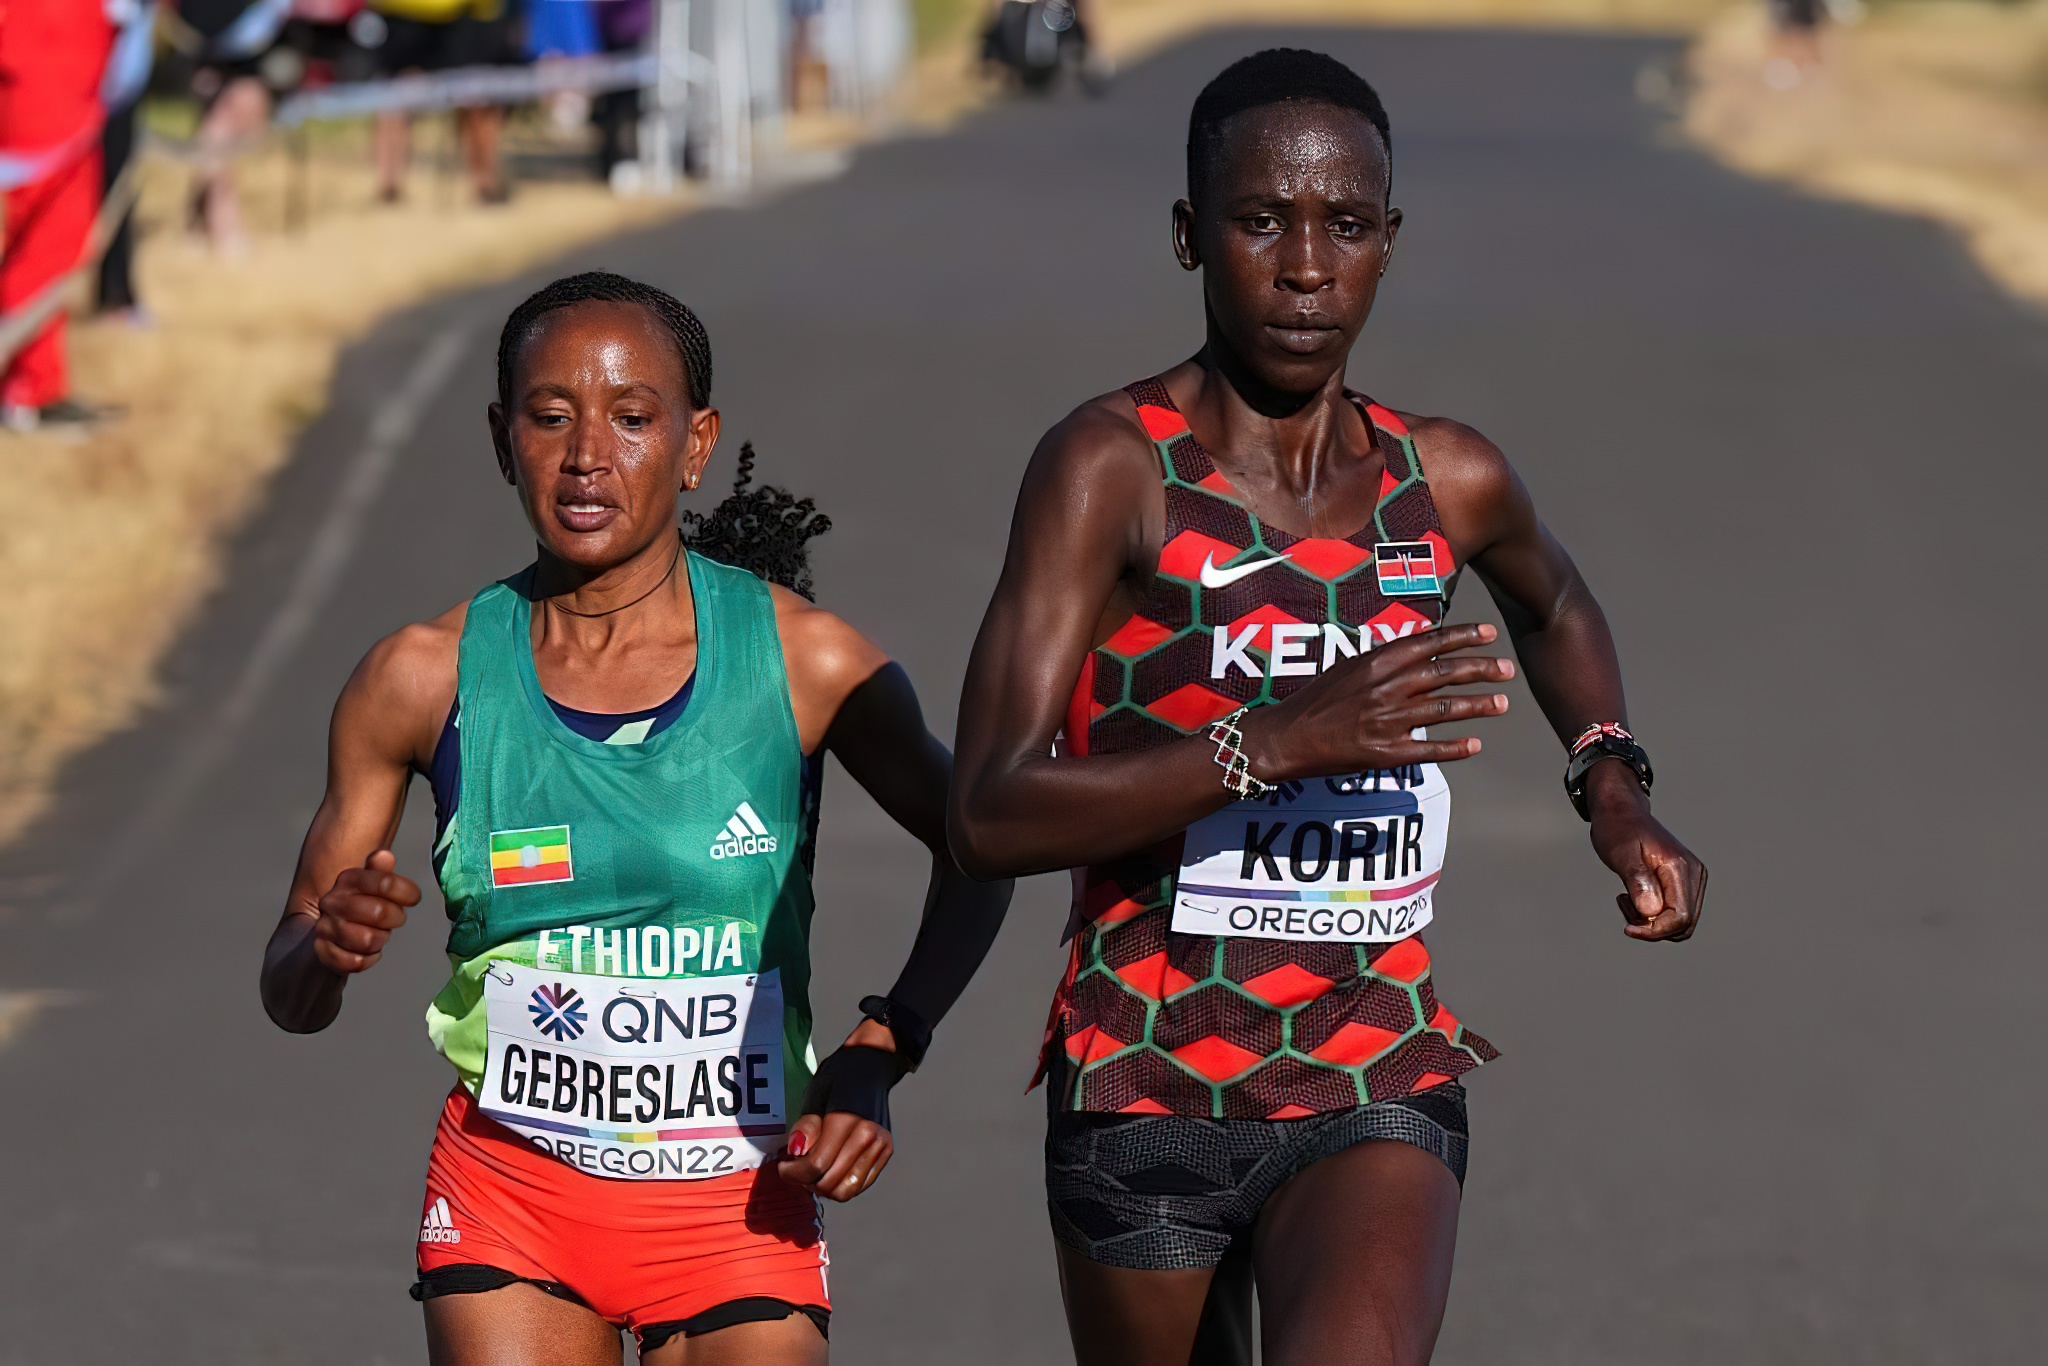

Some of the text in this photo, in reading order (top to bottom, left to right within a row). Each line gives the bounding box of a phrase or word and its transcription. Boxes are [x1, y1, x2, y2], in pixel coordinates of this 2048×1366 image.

[709, 834, 778, 860] adidas
[1240, 813, 1423, 883] KORIR
[537, 921, 743, 977] ETHIOPIA
[601, 993, 738, 1043] QNB
[500, 1043, 771, 1124] GEBRESLASE
